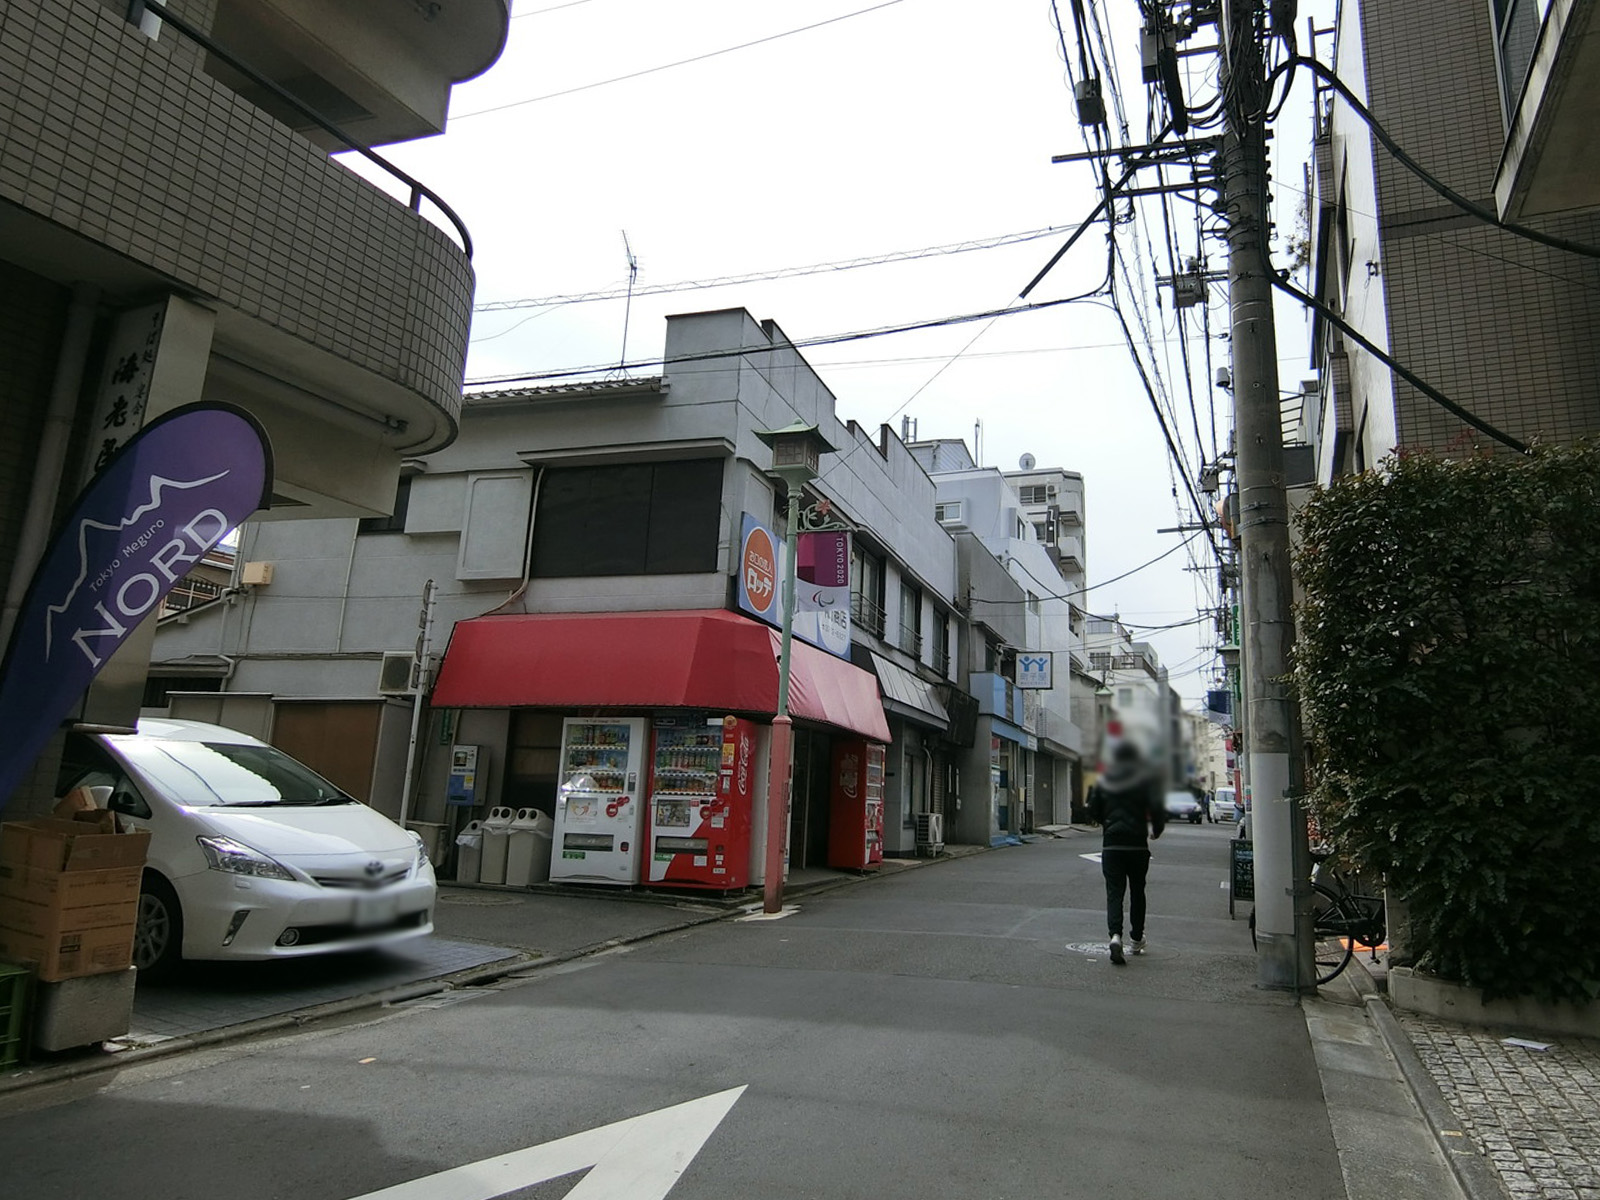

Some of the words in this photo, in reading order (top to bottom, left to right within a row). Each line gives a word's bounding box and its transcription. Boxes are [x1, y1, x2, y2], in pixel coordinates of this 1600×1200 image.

[90, 559, 121, 593] Tokyo
[123, 517, 165, 557] Meguro
[836, 537, 845, 563] TOKYO
[71, 507, 229, 669] NORD
[747, 567, 772, 598] ロッテ
[837, 564, 845, 584] 2020
